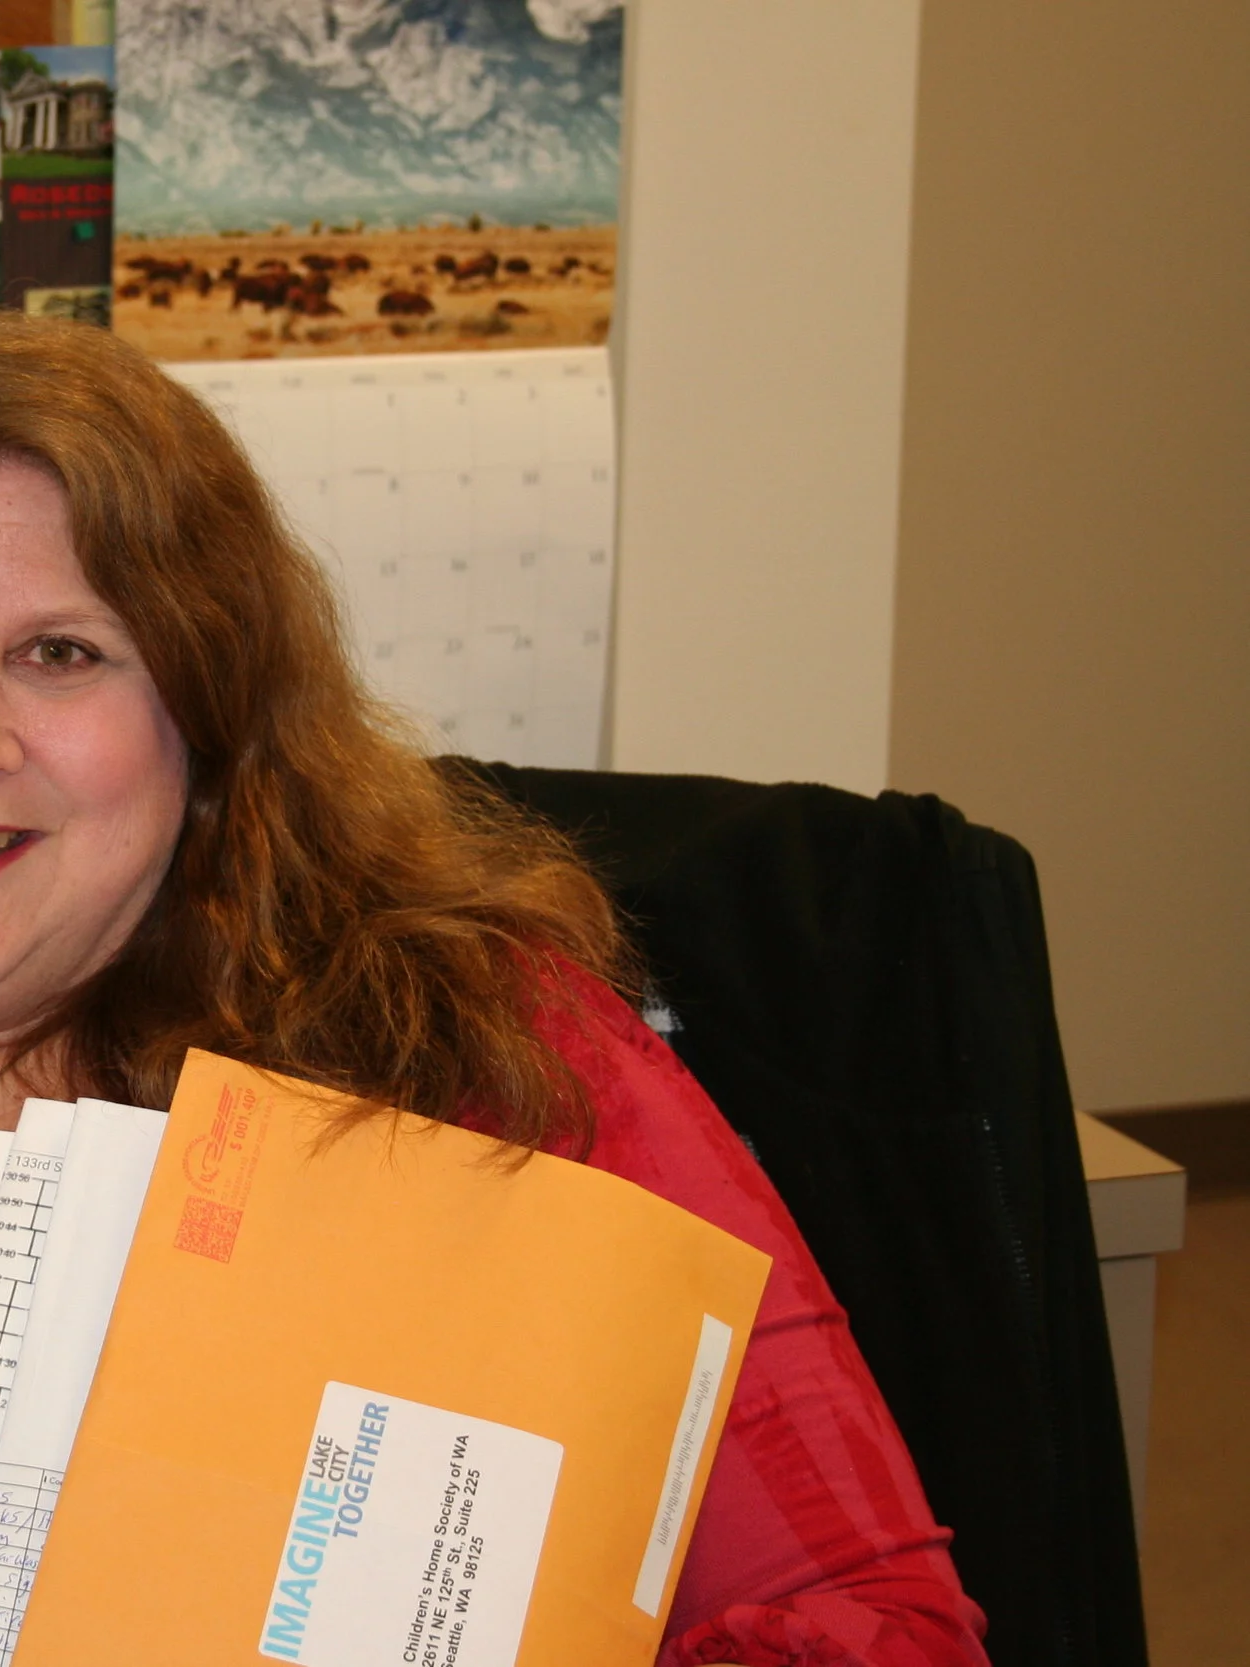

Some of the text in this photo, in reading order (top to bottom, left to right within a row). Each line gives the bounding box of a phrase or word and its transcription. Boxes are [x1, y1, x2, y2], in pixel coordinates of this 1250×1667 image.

[15, 1155, 51, 1171] 133rd
[328, 1445, 350, 1483] CITY
[332, 1402, 390, 1538] TOGETHER
[464, 1469, 480, 1496] 225
[453, 1498, 473, 1536] Suite
[264, 1435, 341, 1659] IMAGINE LAKE
[403, 1433, 469, 1663] Children's Home Society of WA
[438, 1567, 455, 1603] 125th
[454, 1587, 472, 1613] WA
[463, 1536, 484, 1580] 98125
[431, 1607, 447, 1630] NE
